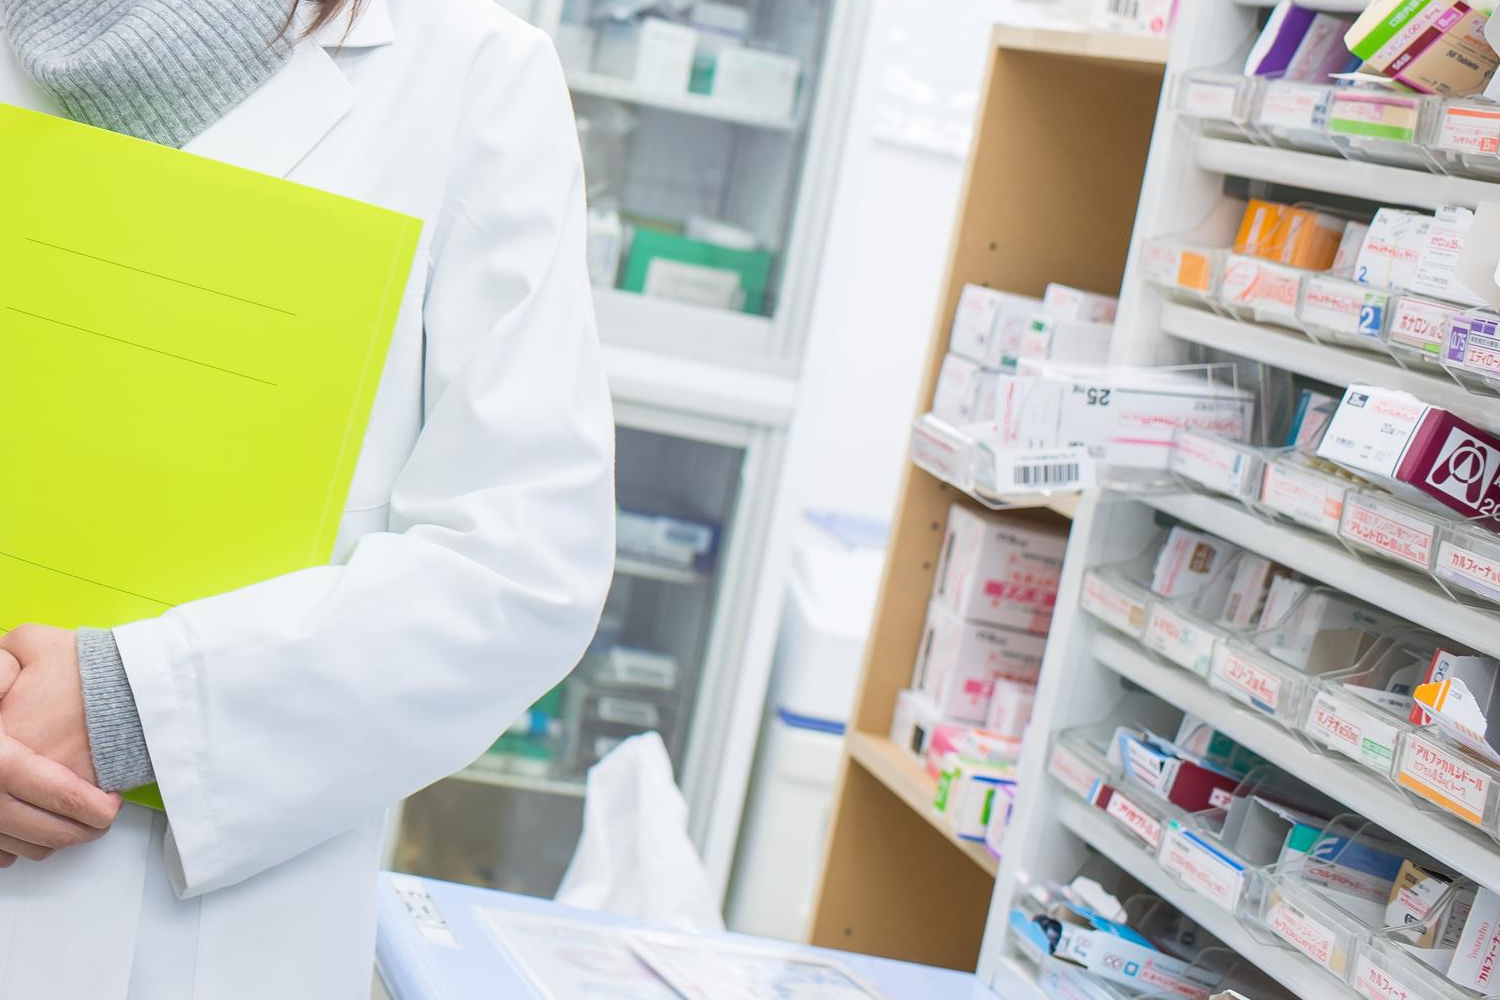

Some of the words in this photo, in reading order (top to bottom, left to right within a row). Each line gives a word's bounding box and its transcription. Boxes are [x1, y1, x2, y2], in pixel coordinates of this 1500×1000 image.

[1087, 387, 1110, 406] 25
[1415, 744, 1483, 792] アルファカルシドール
